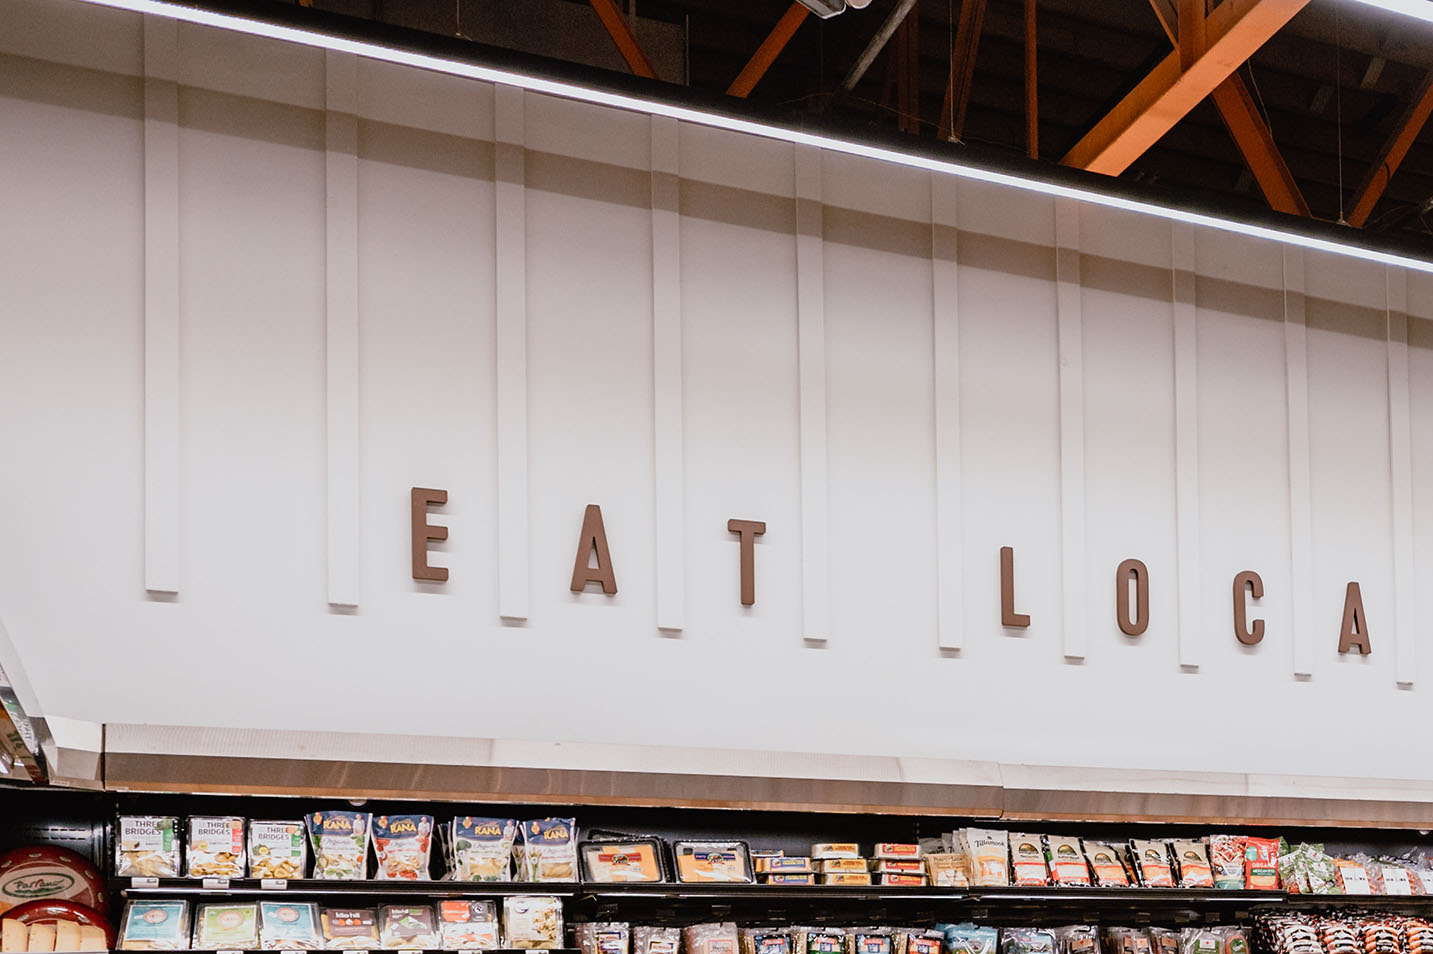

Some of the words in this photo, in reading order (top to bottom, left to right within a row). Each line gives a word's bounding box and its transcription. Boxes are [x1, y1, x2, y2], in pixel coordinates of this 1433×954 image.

[411, 486, 767, 606] EAT
[207, 821, 230, 829] THREE
[266, 826, 289, 834] THREE
[322, 818, 352, 831] RANA
[389, 822, 417, 834] RANA
[475, 822, 502, 836] RANA
[198, 828, 230, 836] BRIDGES
[543, 828, 569, 841] RANA
[974, 840, 1006, 848] Tillamook
[14, 879, 65, 890] Parrano
